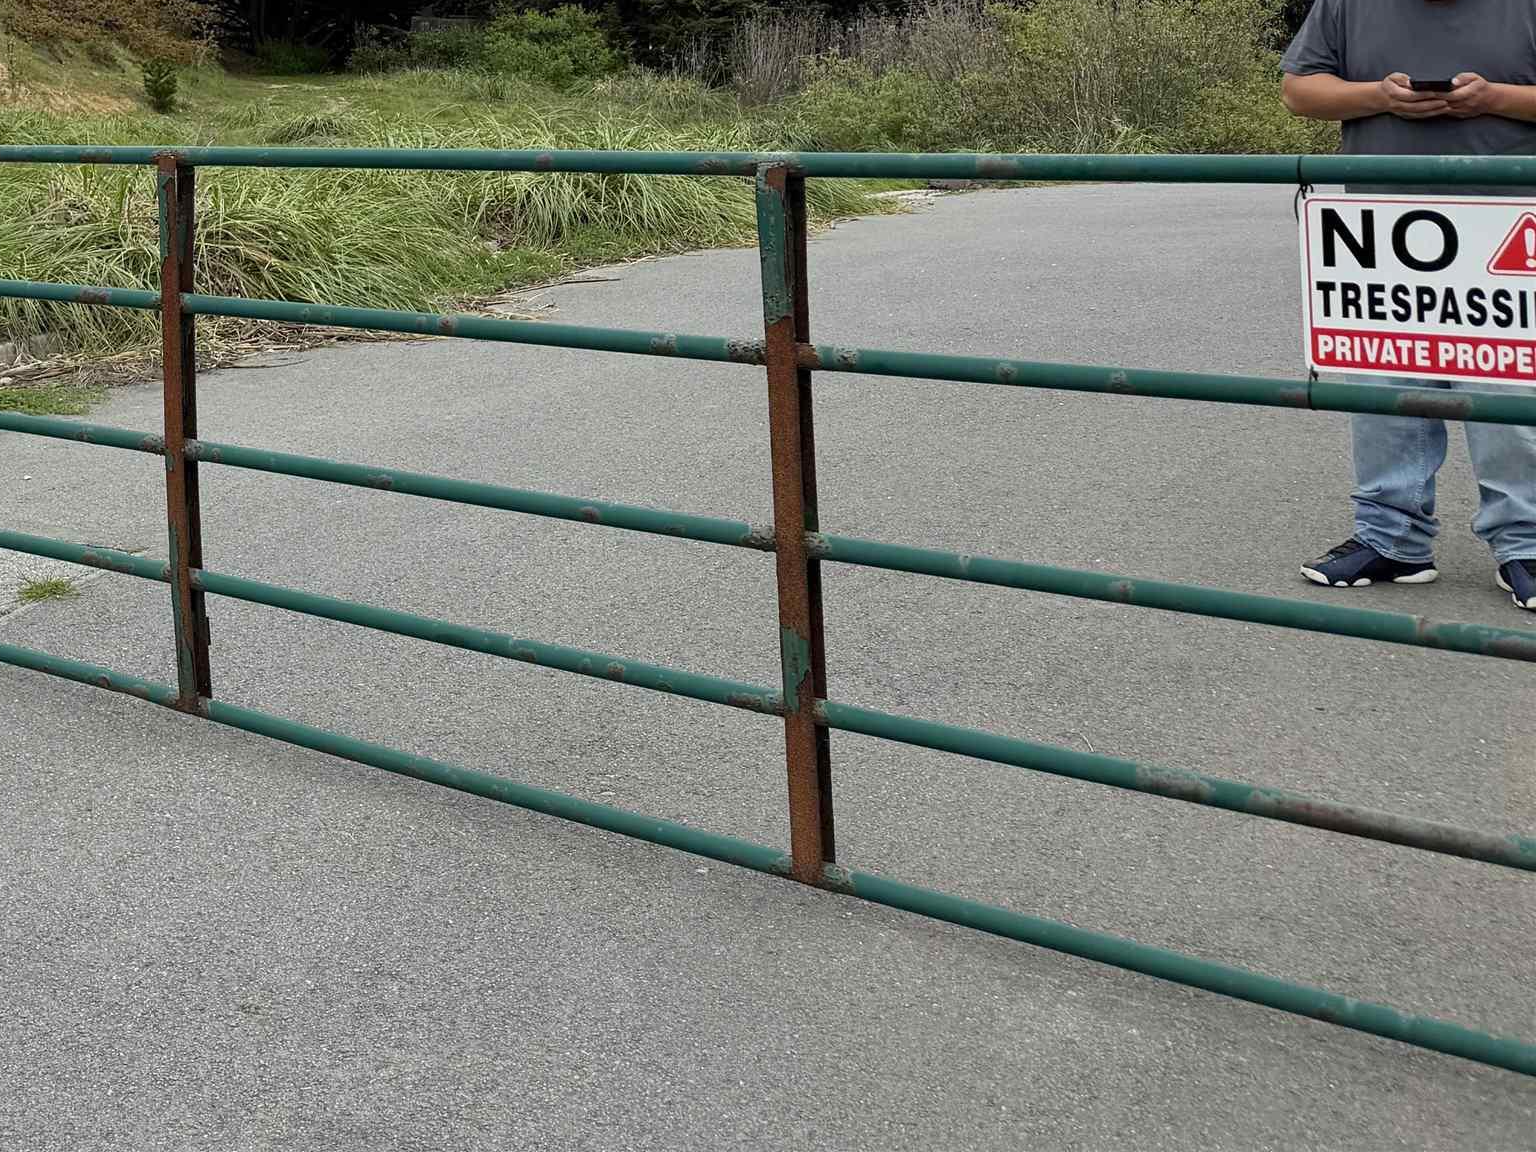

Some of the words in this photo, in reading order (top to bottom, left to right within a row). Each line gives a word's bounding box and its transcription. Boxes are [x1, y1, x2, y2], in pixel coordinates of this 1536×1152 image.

[1321, 208, 1458, 272] NO
[1316, 281, 1536, 329] TRESPASSI
[1318, 335, 1431, 367] PRIVATE
[1439, 342, 1536, 374] PROPE
